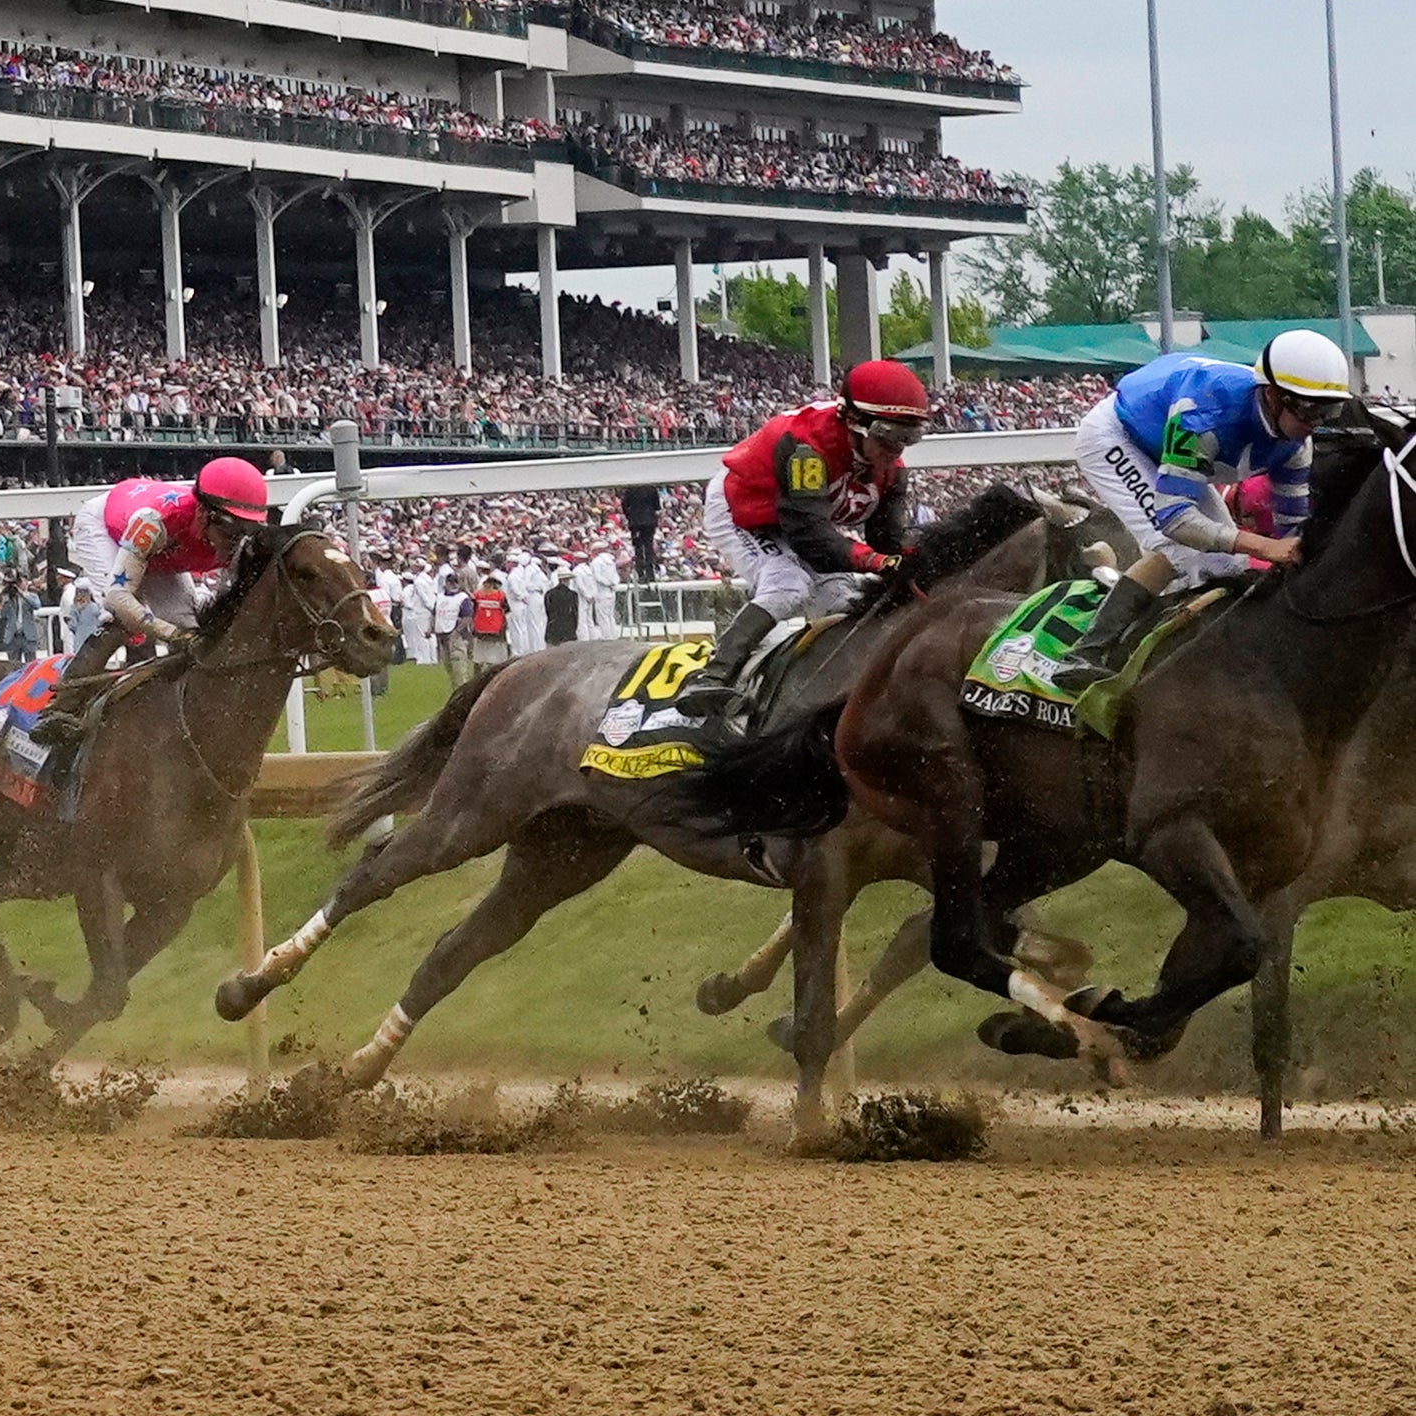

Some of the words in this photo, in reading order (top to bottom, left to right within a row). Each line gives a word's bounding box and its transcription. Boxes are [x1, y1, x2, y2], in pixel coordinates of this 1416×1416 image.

[790, 457, 824, 491] 18
[125, 517, 159, 552] 16
[618, 640, 715, 700] 18
[1036, 700, 1076, 728] ROA
